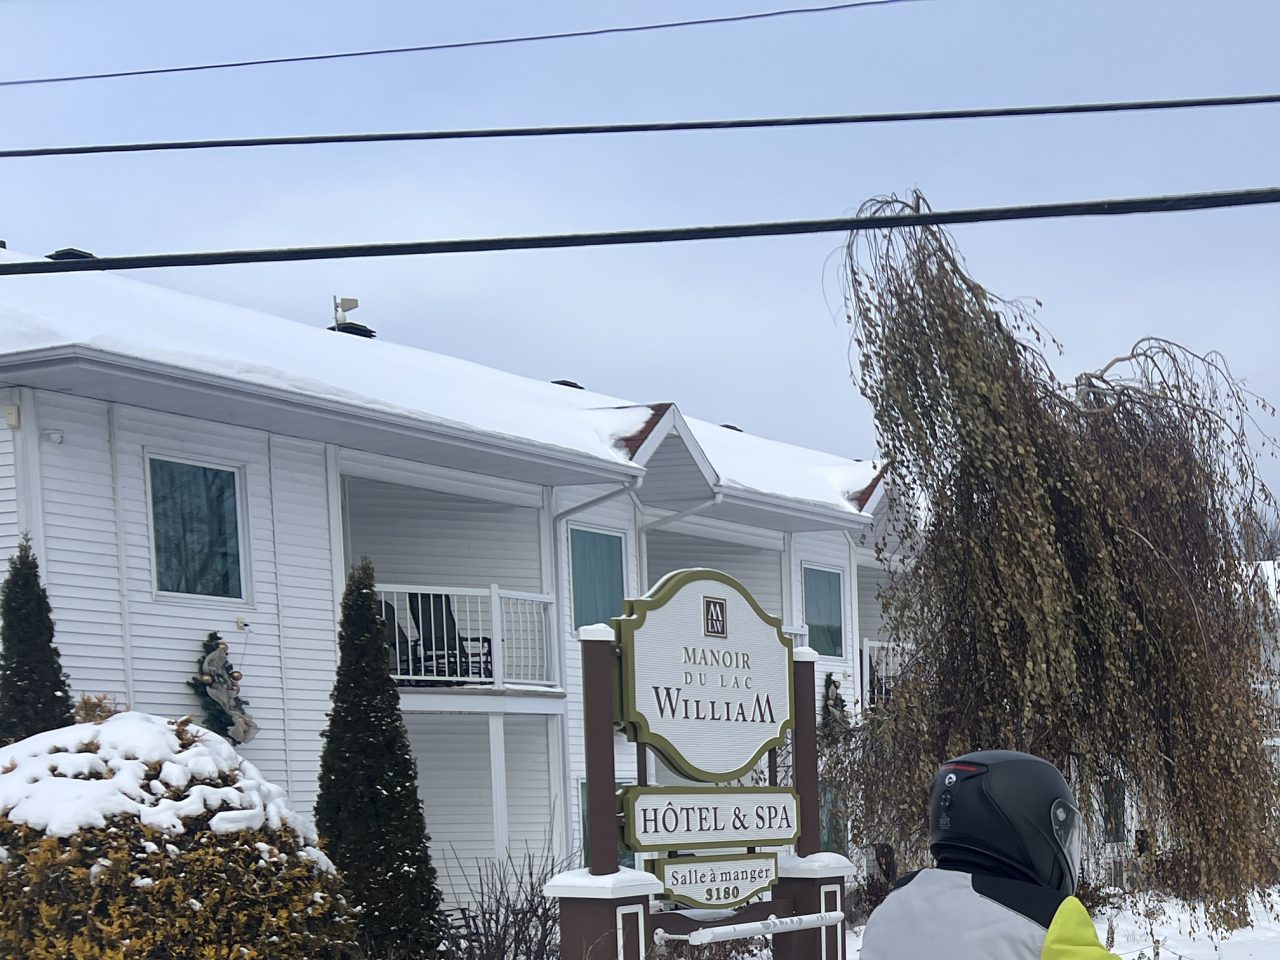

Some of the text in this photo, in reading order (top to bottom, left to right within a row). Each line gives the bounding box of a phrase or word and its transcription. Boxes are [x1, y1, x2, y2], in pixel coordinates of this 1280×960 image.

[683, 646, 751, 670] MANOIR
[684, 671, 752, 690] DU LAC
[652, 686, 776, 724] WILLIAM
[641, 800, 792, 834] HÔTEL & SPA
[671, 867, 771, 886] Salle à manger
[705, 885, 740, 901] 3180
